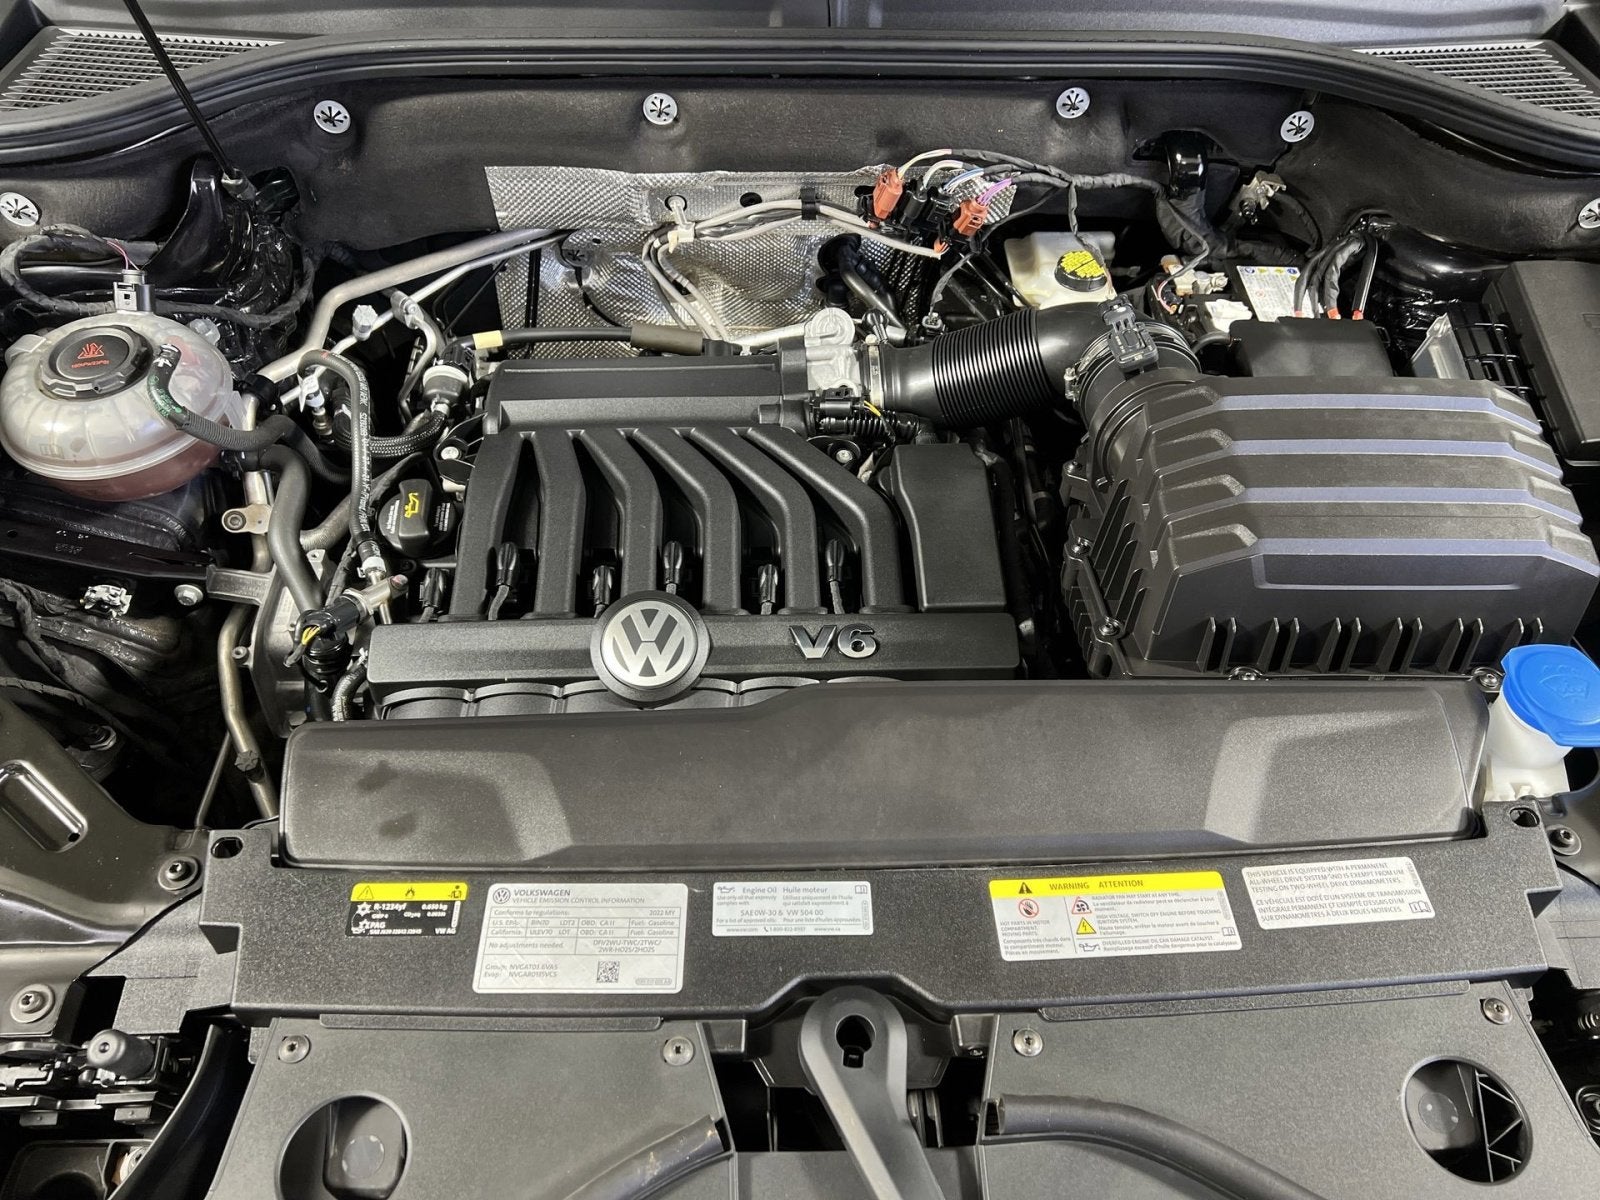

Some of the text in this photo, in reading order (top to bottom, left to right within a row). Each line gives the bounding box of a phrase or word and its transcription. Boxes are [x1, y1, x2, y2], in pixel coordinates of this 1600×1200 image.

[789, 624, 877, 660] V6
[1263, 869, 1287, 877] VEHICLE
[1295, 866, 1326, 875] EQUIPPED
[1327, 865, 1344, 873] WITH
[1351, 862, 1388, 871] PERMANENT
[1250, 877, 1283, 886] ALL-WHEEL
[1304, 874, 1326, 882] SYSTEM
[1351, 871, 1376, 879] EXEMPT
[1049, 879, 1144, 890] WARNING ATTENTION
[1252, 885, 1277, 893] TESTING
[1290, 882, 1329, 891] TWO-WHEEL
[1330, 880, 1349, 888] DRIVE
[743, 887, 766, 895] Engine
[1377, 889, 1421, 898] TRANSMISSION
[1292, 903, 1327, 911] PERMANENT
[740, 909, 754, 917] SAE
